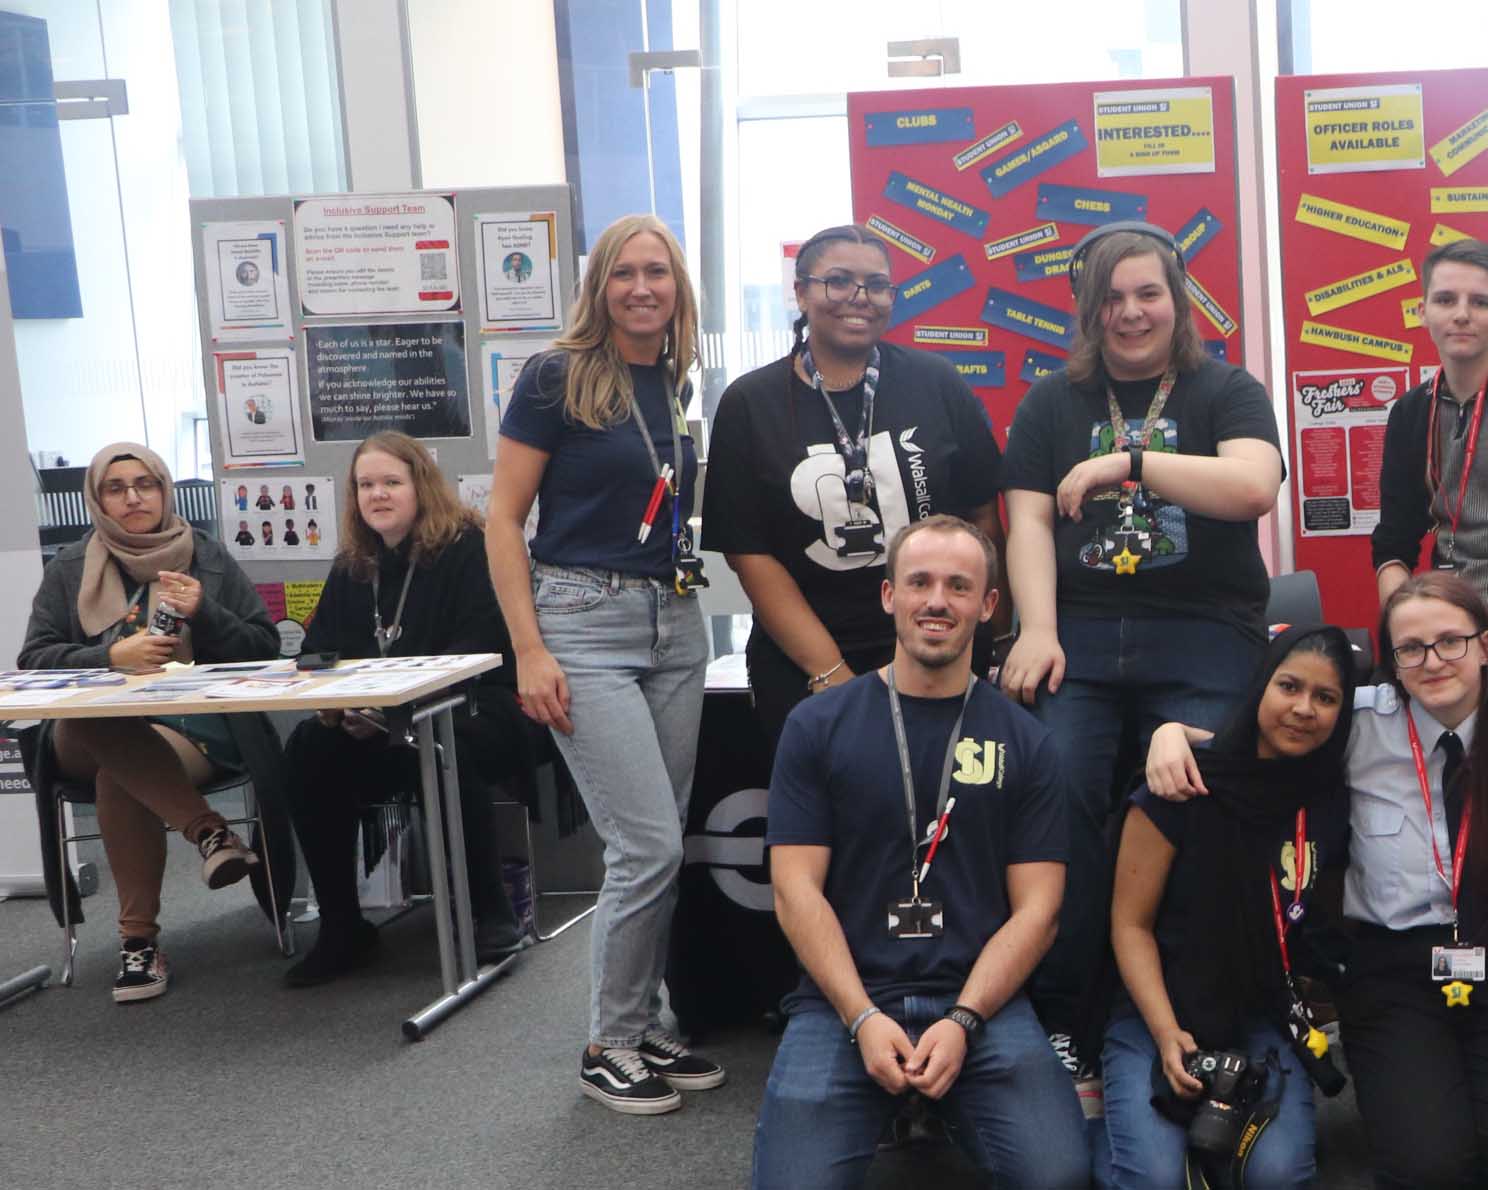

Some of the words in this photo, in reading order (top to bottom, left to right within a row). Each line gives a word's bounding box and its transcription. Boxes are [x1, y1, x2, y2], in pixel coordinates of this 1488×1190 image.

[1099, 104, 1132, 113] STUDENT
[1133, 104, 1157, 112] UNION
[1309, 102, 1342, 111] STUDENT
[1343, 101, 1368, 110] UNION
[897, 115, 936, 128] CLUBS
[1314, 121, 1368, 135] OFFICER
[1372, 119, 1414, 131] ROLES
[1330, 137, 1400, 151] AVAILABLE
[905, 182, 940, 202] MENTAL
[941, 196, 973, 217] HEALTH
[1074, 200, 1111, 212] CHESS
[323, 207, 362, 216] Inclusive
[365, 205, 400, 216] Support
[403, 204, 425, 214] Team
[916, 199, 955, 220] MONDAY
[1307, 204, 1343, 222] HIGHER
[1345, 216, 1400, 237] EDUCATION
[869, 217, 901, 238] STUDENT
[900, 232, 922, 251] UNION
[988, 240, 1019, 256] STUDENT
[904, 280, 932, 299] DARTS
[1315, 275, 1374, 302] DISABILITIES
[1377, 272, 1384, 280] &
[1386, 264, 1405, 276] ALS
[1007, 308, 1033, 325] TABLE
[1033, 316, 1066, 335] TENNIS
[340, 339, 348, 347] of
[395, 337, 420, 348] Eager
[421, 337, 430, 345] to
[432, 336, 443, 344] be
[916, 330, 949, 339] STUDENT
[950, 331, 974, 339] UNION
[1310, 327, 1360, 344] HAWBUSH
[1362, 336, 1404, 352] CAMPUS
[316, 352, 360, 361] discovered
[363, 351, 378, 360] and
[379, 350, 408, 359] named
[410, 350, 417, 358] in
[419, 349, 433, 357] the
[956, 365, 988, 374] RAFTS
[319, 381, 325, 389] If
[326, 381, 341, 390] you
[343, 379, 397, 389] acknowledge
[413, 377, 446, 386] abilities
[333, 393, 348, 401] can
[350, 391, 371, 400] shine
[373, 390, 408, 401] brighter.
[410, 390, 424, 398] We
[425, 388, 445, 397] have
[1303, 382, 1364, 404] Freshers'
[321, 405, 344, 414] much
[345, 405, 354, 413] to
[356, 405, 372, 414] say,
[374, 403, 400, 414] please
[401, 402, 420, 411] hear
[1313, 400, 1345, 417] Fair
[908, 453, 932, 501] Walsall
[1237, 1123, 1258, 1157] Nikon
